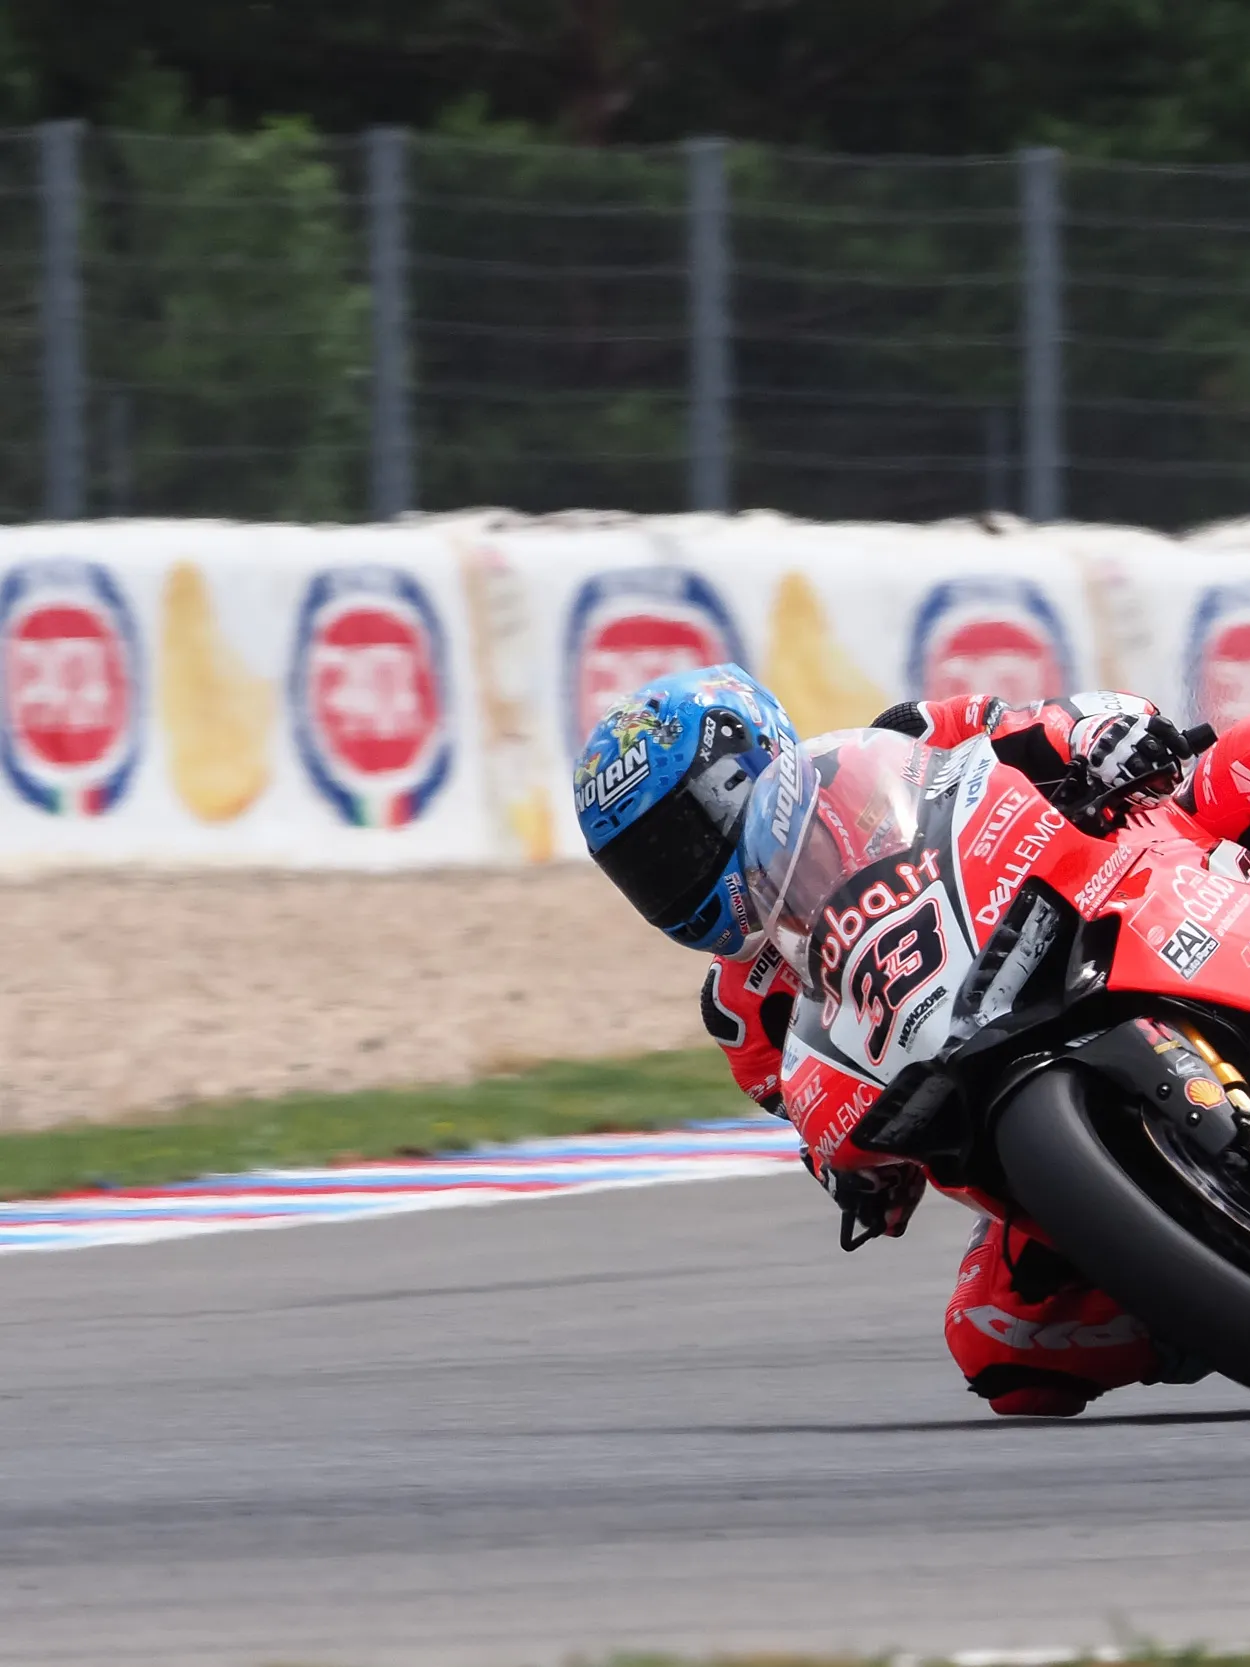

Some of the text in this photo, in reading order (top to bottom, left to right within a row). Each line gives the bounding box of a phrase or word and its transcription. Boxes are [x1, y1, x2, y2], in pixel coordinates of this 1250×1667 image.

[575, 739, 649, 814] NOLAN
[771, 726, 800, 847] NOLAN
[973, 790, 1029, 858] STULZ
[1183, 872, 1236, 922] CLOUD
[820, 847, 941, 1030] aruba.it
[1161, 919, 1210, 970] FAI
[848, 896, 948, 1064] 33
